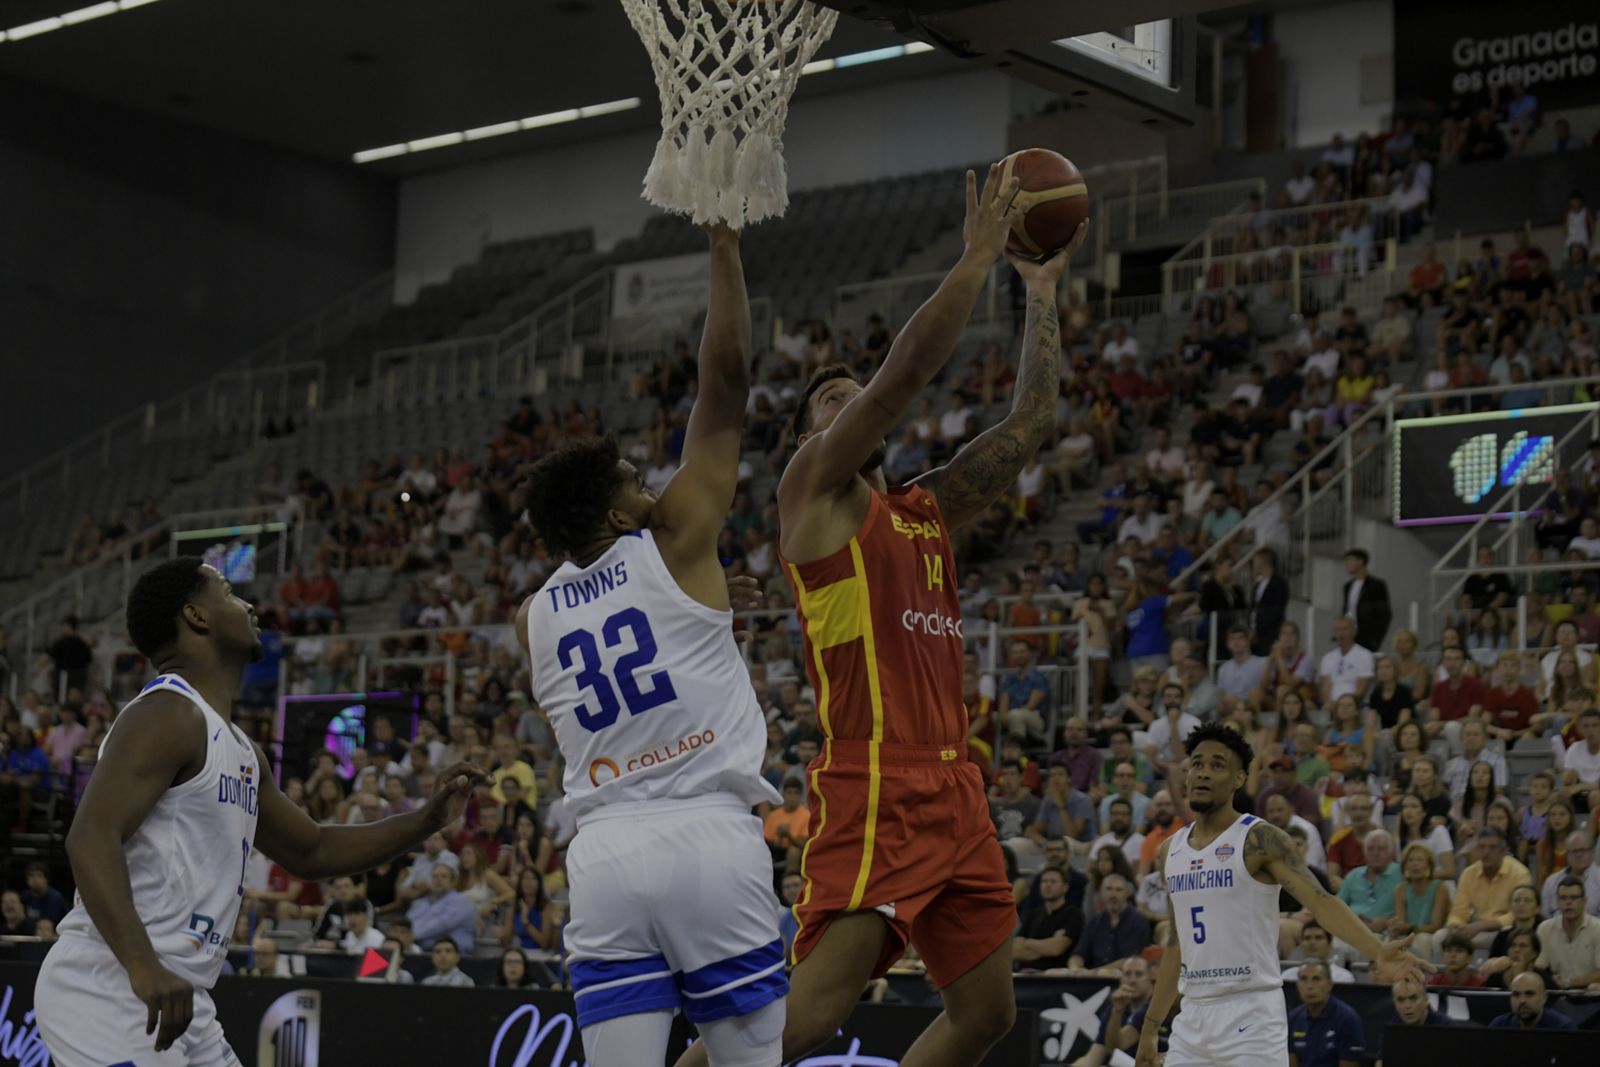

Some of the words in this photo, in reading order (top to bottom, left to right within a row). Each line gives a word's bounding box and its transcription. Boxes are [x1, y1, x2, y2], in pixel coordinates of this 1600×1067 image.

[1452, 21, 1599, 67] Granada
[1452, 70, 1484, 94] es
[1486, 53, 1598, 89] deporte
[547, 561, 629, 613] TOWNS
[923, 553, 944, 592] 14
[557, 606, 678, 733] 32
[627, 729, 715, 772] COLLADO
[1167, 868, 1233, 893] OMINICANA
[1191, 906, 1206, 944] 5
